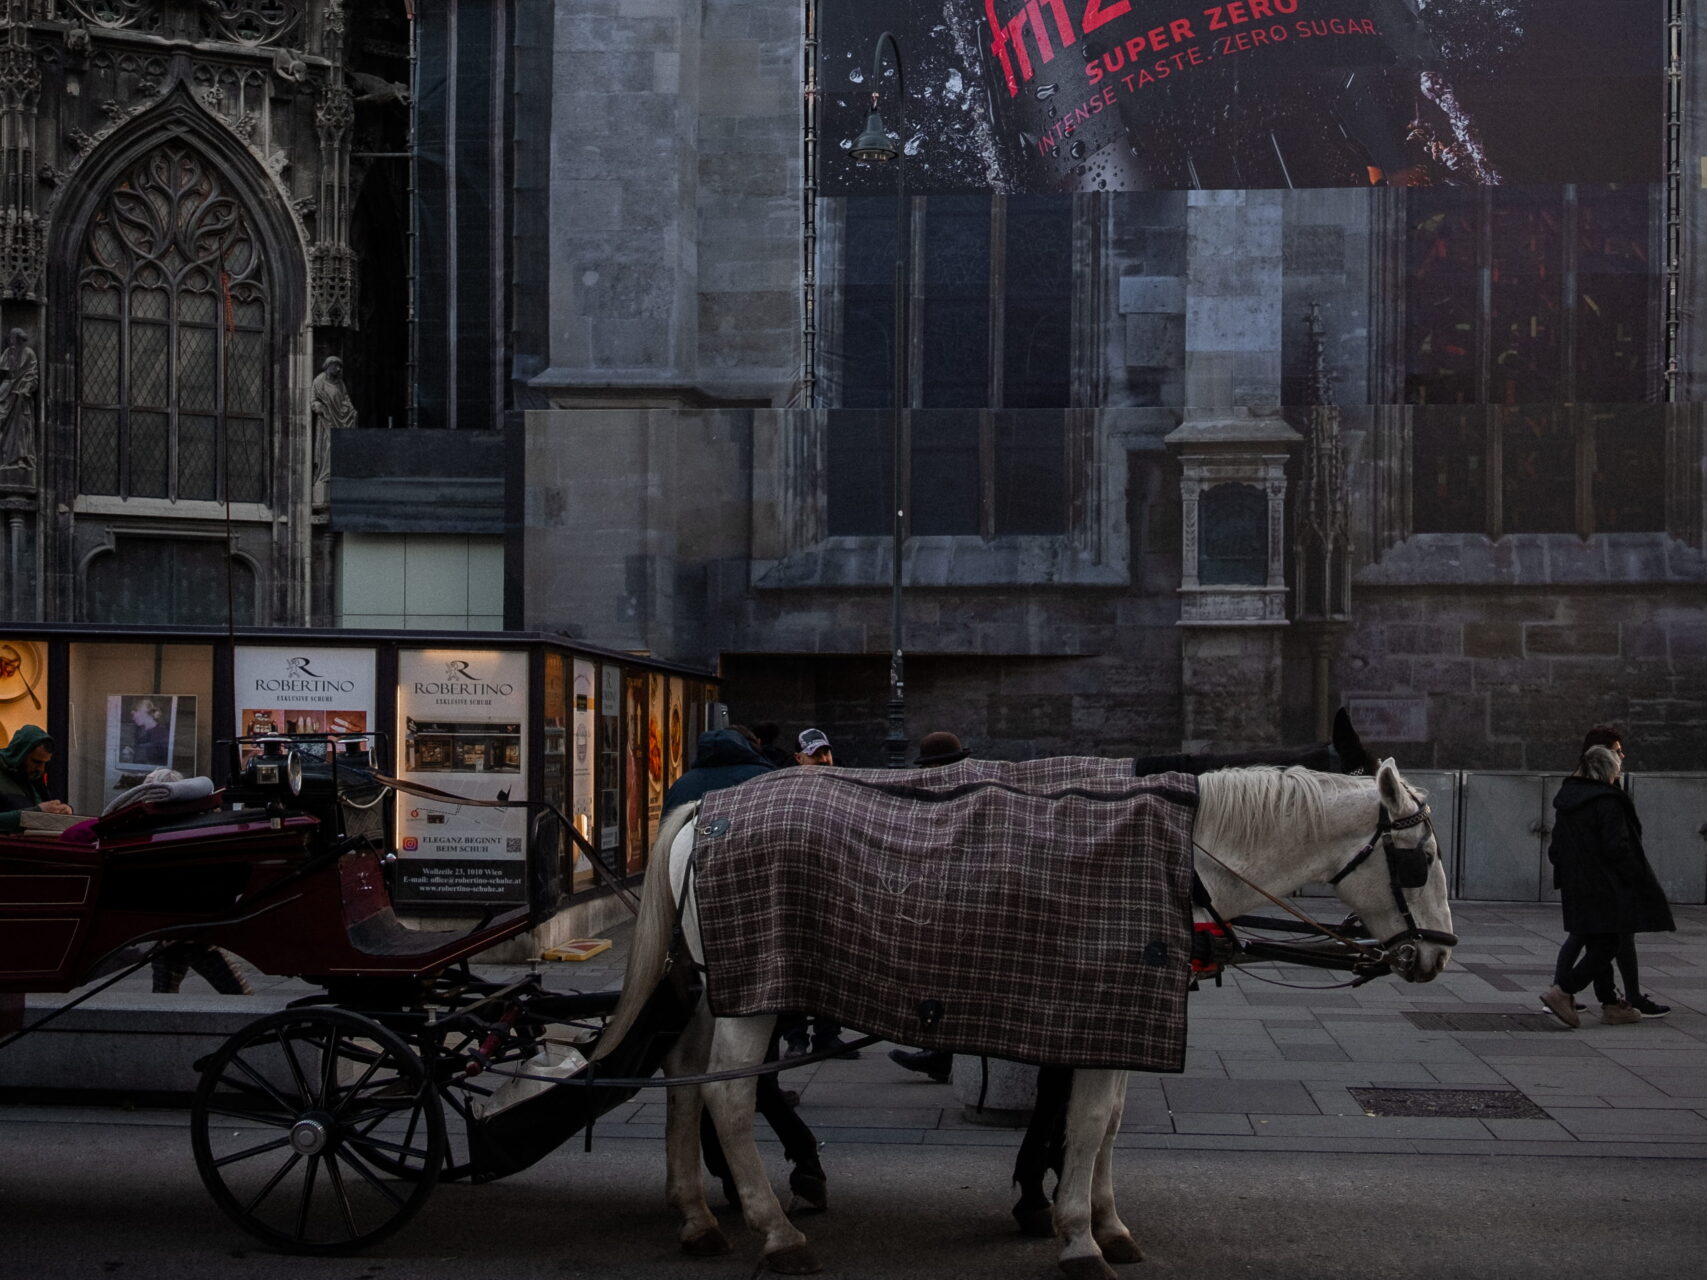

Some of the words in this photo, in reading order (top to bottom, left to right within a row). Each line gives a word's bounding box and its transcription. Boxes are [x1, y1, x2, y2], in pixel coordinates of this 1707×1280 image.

[1084, 18, 1196, 86] SUPER
[1036, 85, 1119, 158] INTENSE
[1121, 45, 1214, 95] TASTE.
[1221, 25, 1289, 57] ZERO
[255, 679, 355, 693] ROBERTINO
[414, 682, 514, 696] ROBERTINO
[276, 695, 308, 703] EXKLUSIVE
[435, 698, 468, 706] EXKLUSIVE
[423, 836, 463, 844] ELEGANZ
[465, 837, 503, 845] BEGINNT
[436, 845, 458, 853] BEIM
[459, 845, 489, 853] SCHUH
[466, 868, 483, 876] 1010
[484, 868, 503, 876] Wien
[403, 876, 429, 884] E-mail:
